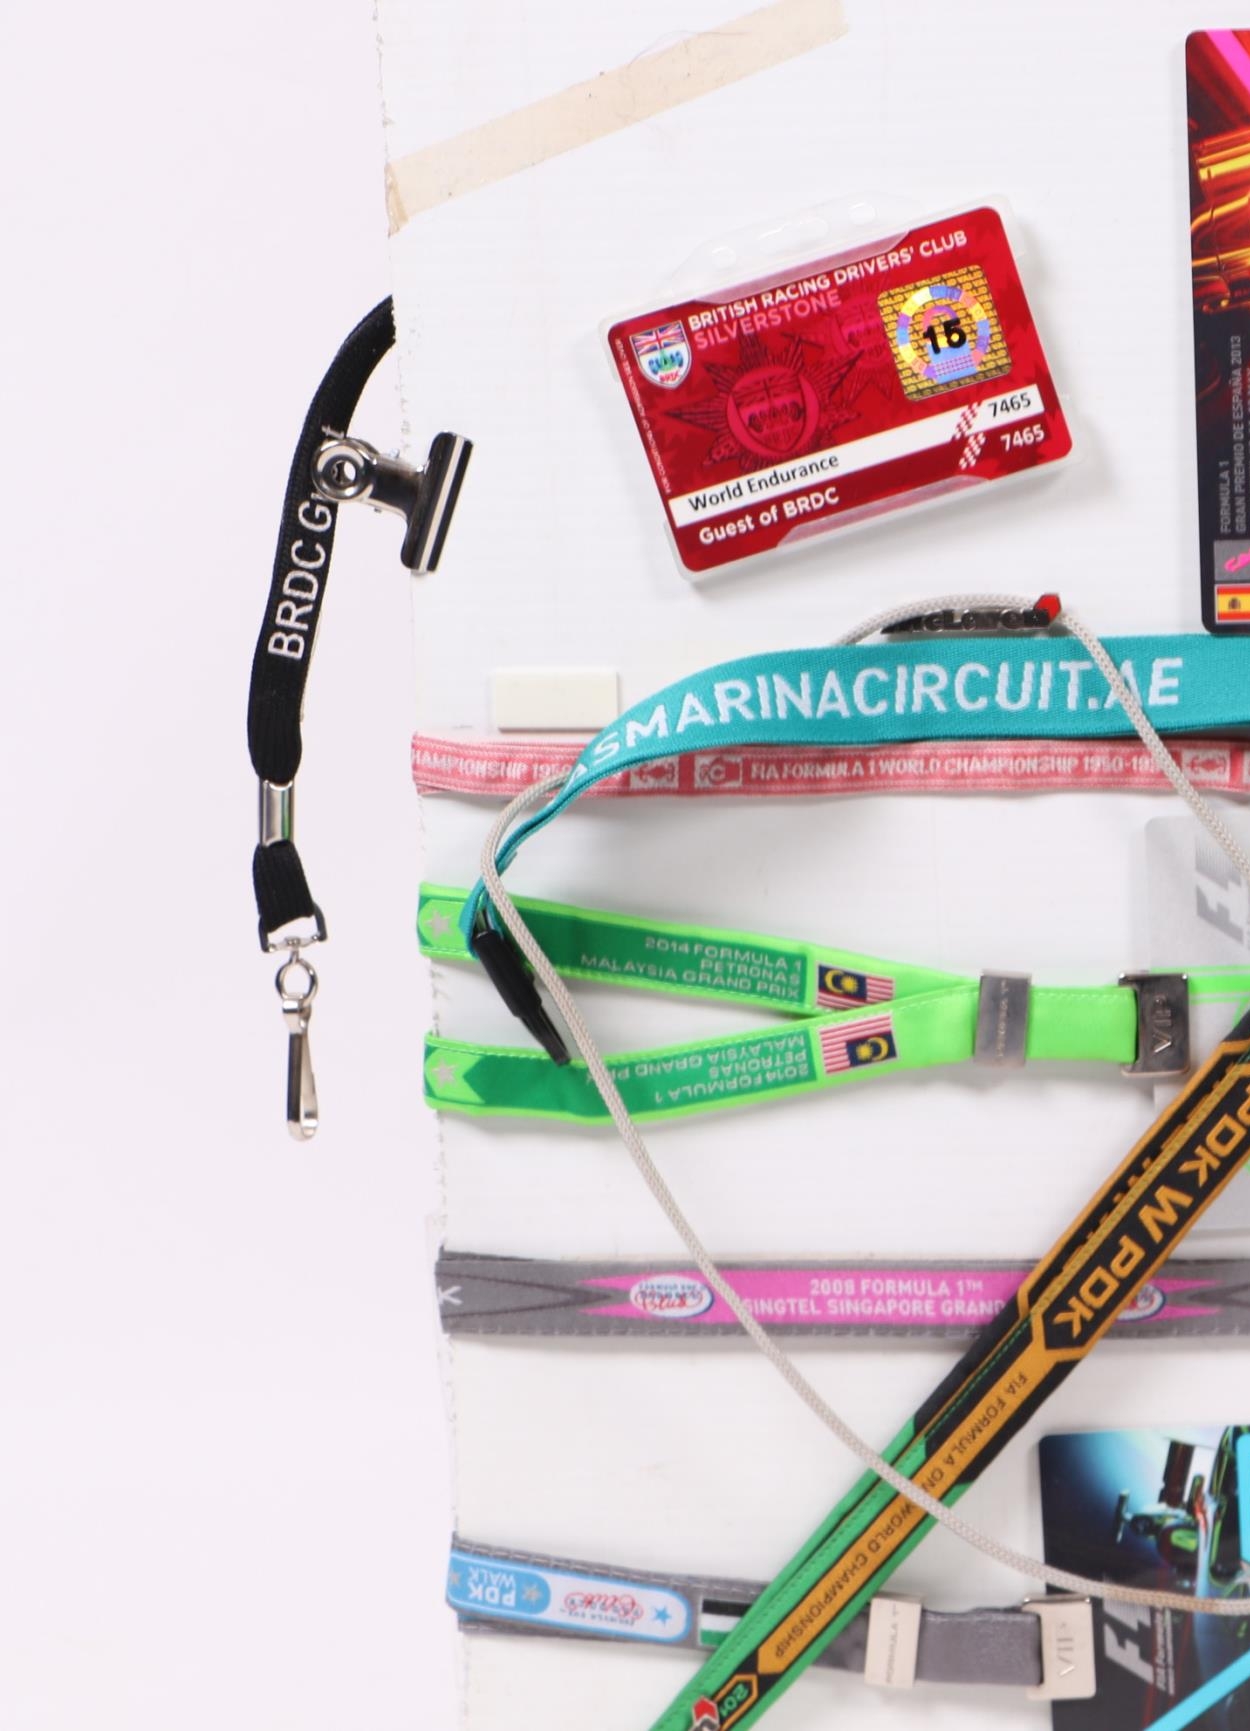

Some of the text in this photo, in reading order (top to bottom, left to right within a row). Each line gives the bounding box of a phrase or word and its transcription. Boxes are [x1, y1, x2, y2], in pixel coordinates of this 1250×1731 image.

[688, 230, 968, 332] BRITISH RACING DRIVERS' CLUB
[694, 290, 843, 350] SILVERSTONE
[922, 317, 967, 355] 15
[988, 392, 1032, 418] 7465
[1000, 424, 1045, 452] 7465
[1229, 336, 1246, 533] GRAN PREMIO DE ESPAÑA 2013
[688, 452, 840, 514] World Endurance
[1219, 470, 1231, 534] FORMULA
[699, 487, 840, 546] Guest of BRDC
[268, 540, 326, 660] BRDC
[750, 763, 779, 780] FIA
[782, 761, 864, 779] FORMULA
[878, 757, 941, 775] WORLD
[944, 754, 1079, 776] CHAMPIONSHIP
[645, 937, 690, 955] 2014
[694, 944, 789, 970] FORMULA
[700, 959, 801, 986] PETRONAS
[581, 954, 800, 999] MALAYSIA GRAND PRIX
[1151, 992, 1176, 1054] VIP
[635, 1035, 805, 1076] MALAYSIA GRAND
[708, 1050, 807, 1078] PETRONAS
[765, 1063, 809, 1081] 2014
[668, 1072, 763, 1101] FORMULA
[1138, 1185, 1195, 1244] W
[810, 1278, 855, 1297] 2008
[860, 1278, 950, 1297] FORMULA
[1053, 1235, 1146, 1339] PDK
[827, 1299, 937, 1317] SINGAPORE
[774, 1372, 1028, 1660] FIA FORMULA ON WORLD CHAMPIONSHIP
[467, 1582, 516, 1608] PDK
[468, 1567, 517, 1587] WALK
[1057, 1620, 1076, 1678] VIP
[719, 1682, 749, 1718] 201
